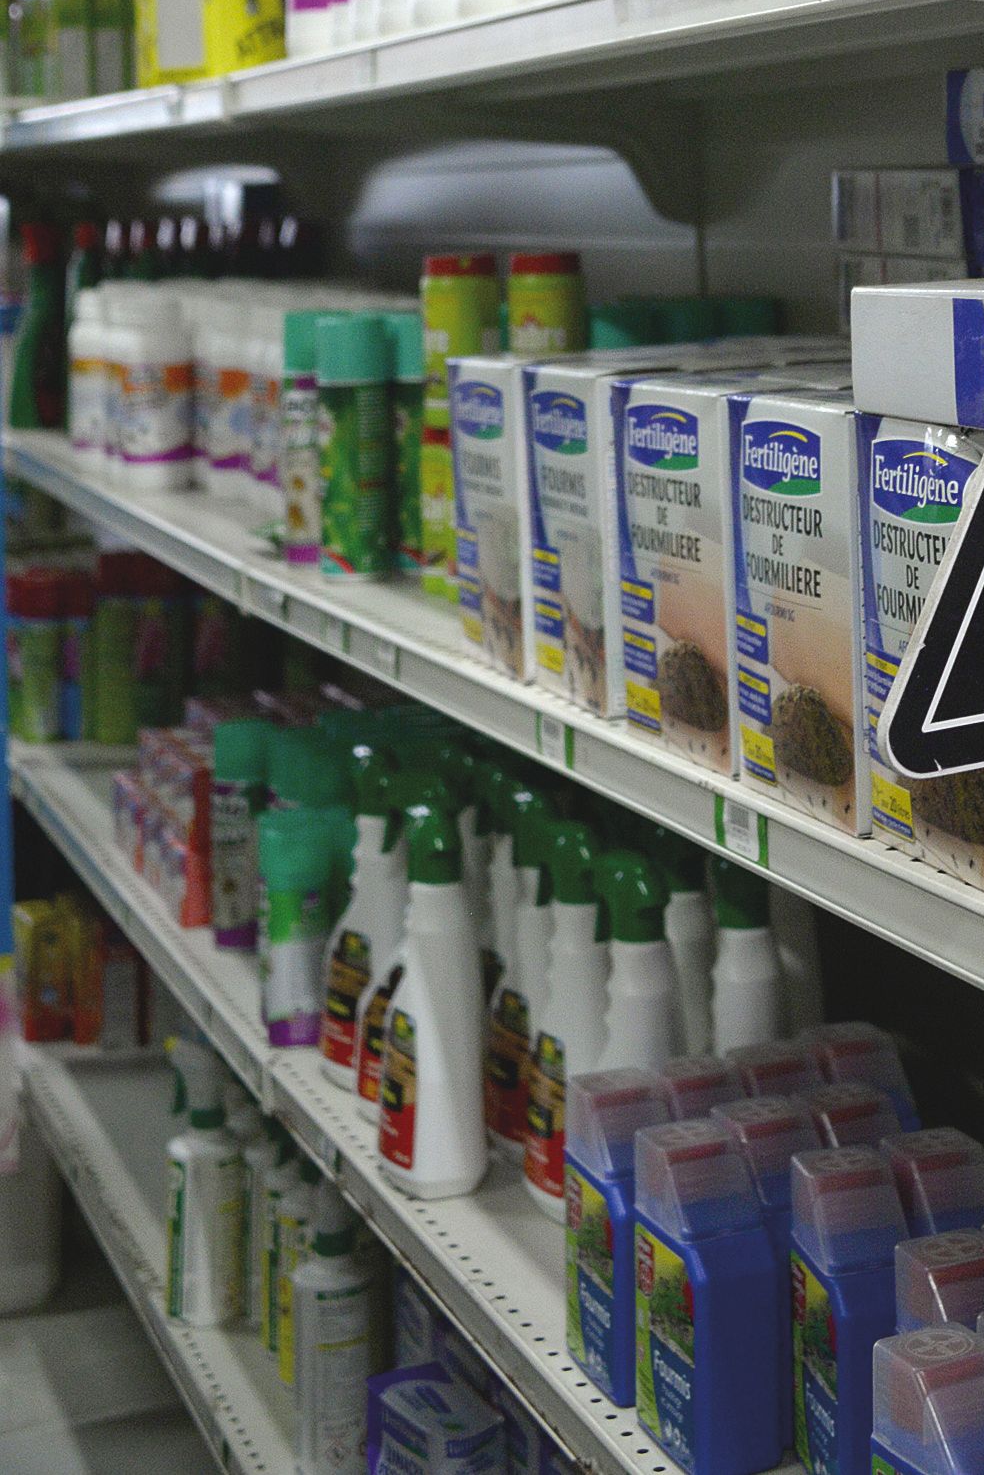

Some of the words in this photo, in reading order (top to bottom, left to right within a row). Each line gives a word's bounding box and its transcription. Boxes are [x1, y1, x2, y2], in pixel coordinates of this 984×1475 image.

[628, 417, 697, 459] Fertiligène
[744, 434, 818, 483] Fertiligène
[628, 472, 702, 509] DESTRUCTEUR
[875, 455, 959, 508] Fertiligène
[743, 494, 823, 539] DESTRUCTEUR
[772, 533, 784, 557] DE
[873, 520, 949, 566] DESTRUCTE
[747, 551, 822, 599] FOURMILIERE
[906, 564, 920, 591] DE
[876, 583, 926, 625] FOURMI
